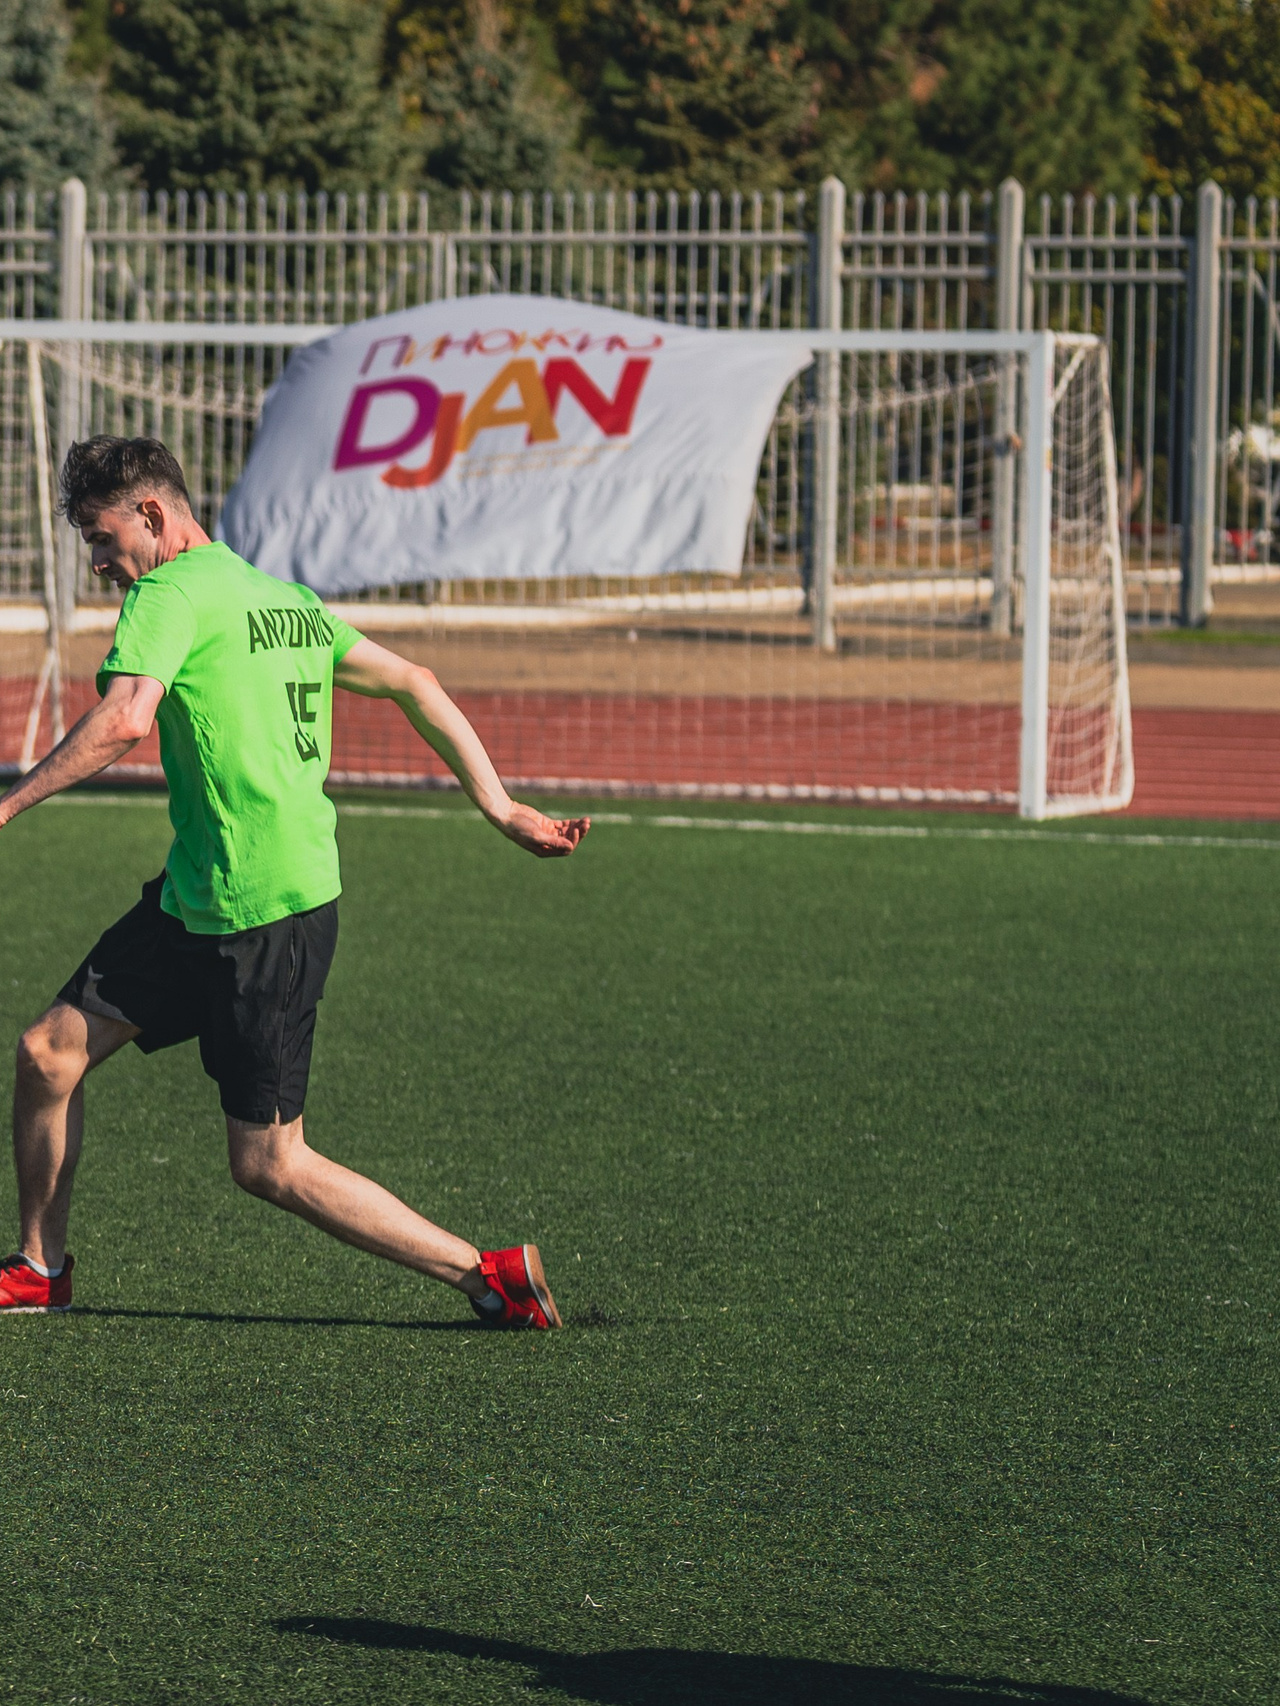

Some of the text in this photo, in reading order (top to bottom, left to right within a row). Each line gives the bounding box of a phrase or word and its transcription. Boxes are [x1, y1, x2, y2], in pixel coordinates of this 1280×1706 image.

[332, 357, 652, 489] DJAN
[247, 608, 335, 654] ANTONIO
[284, 682, 322, 762] 15
